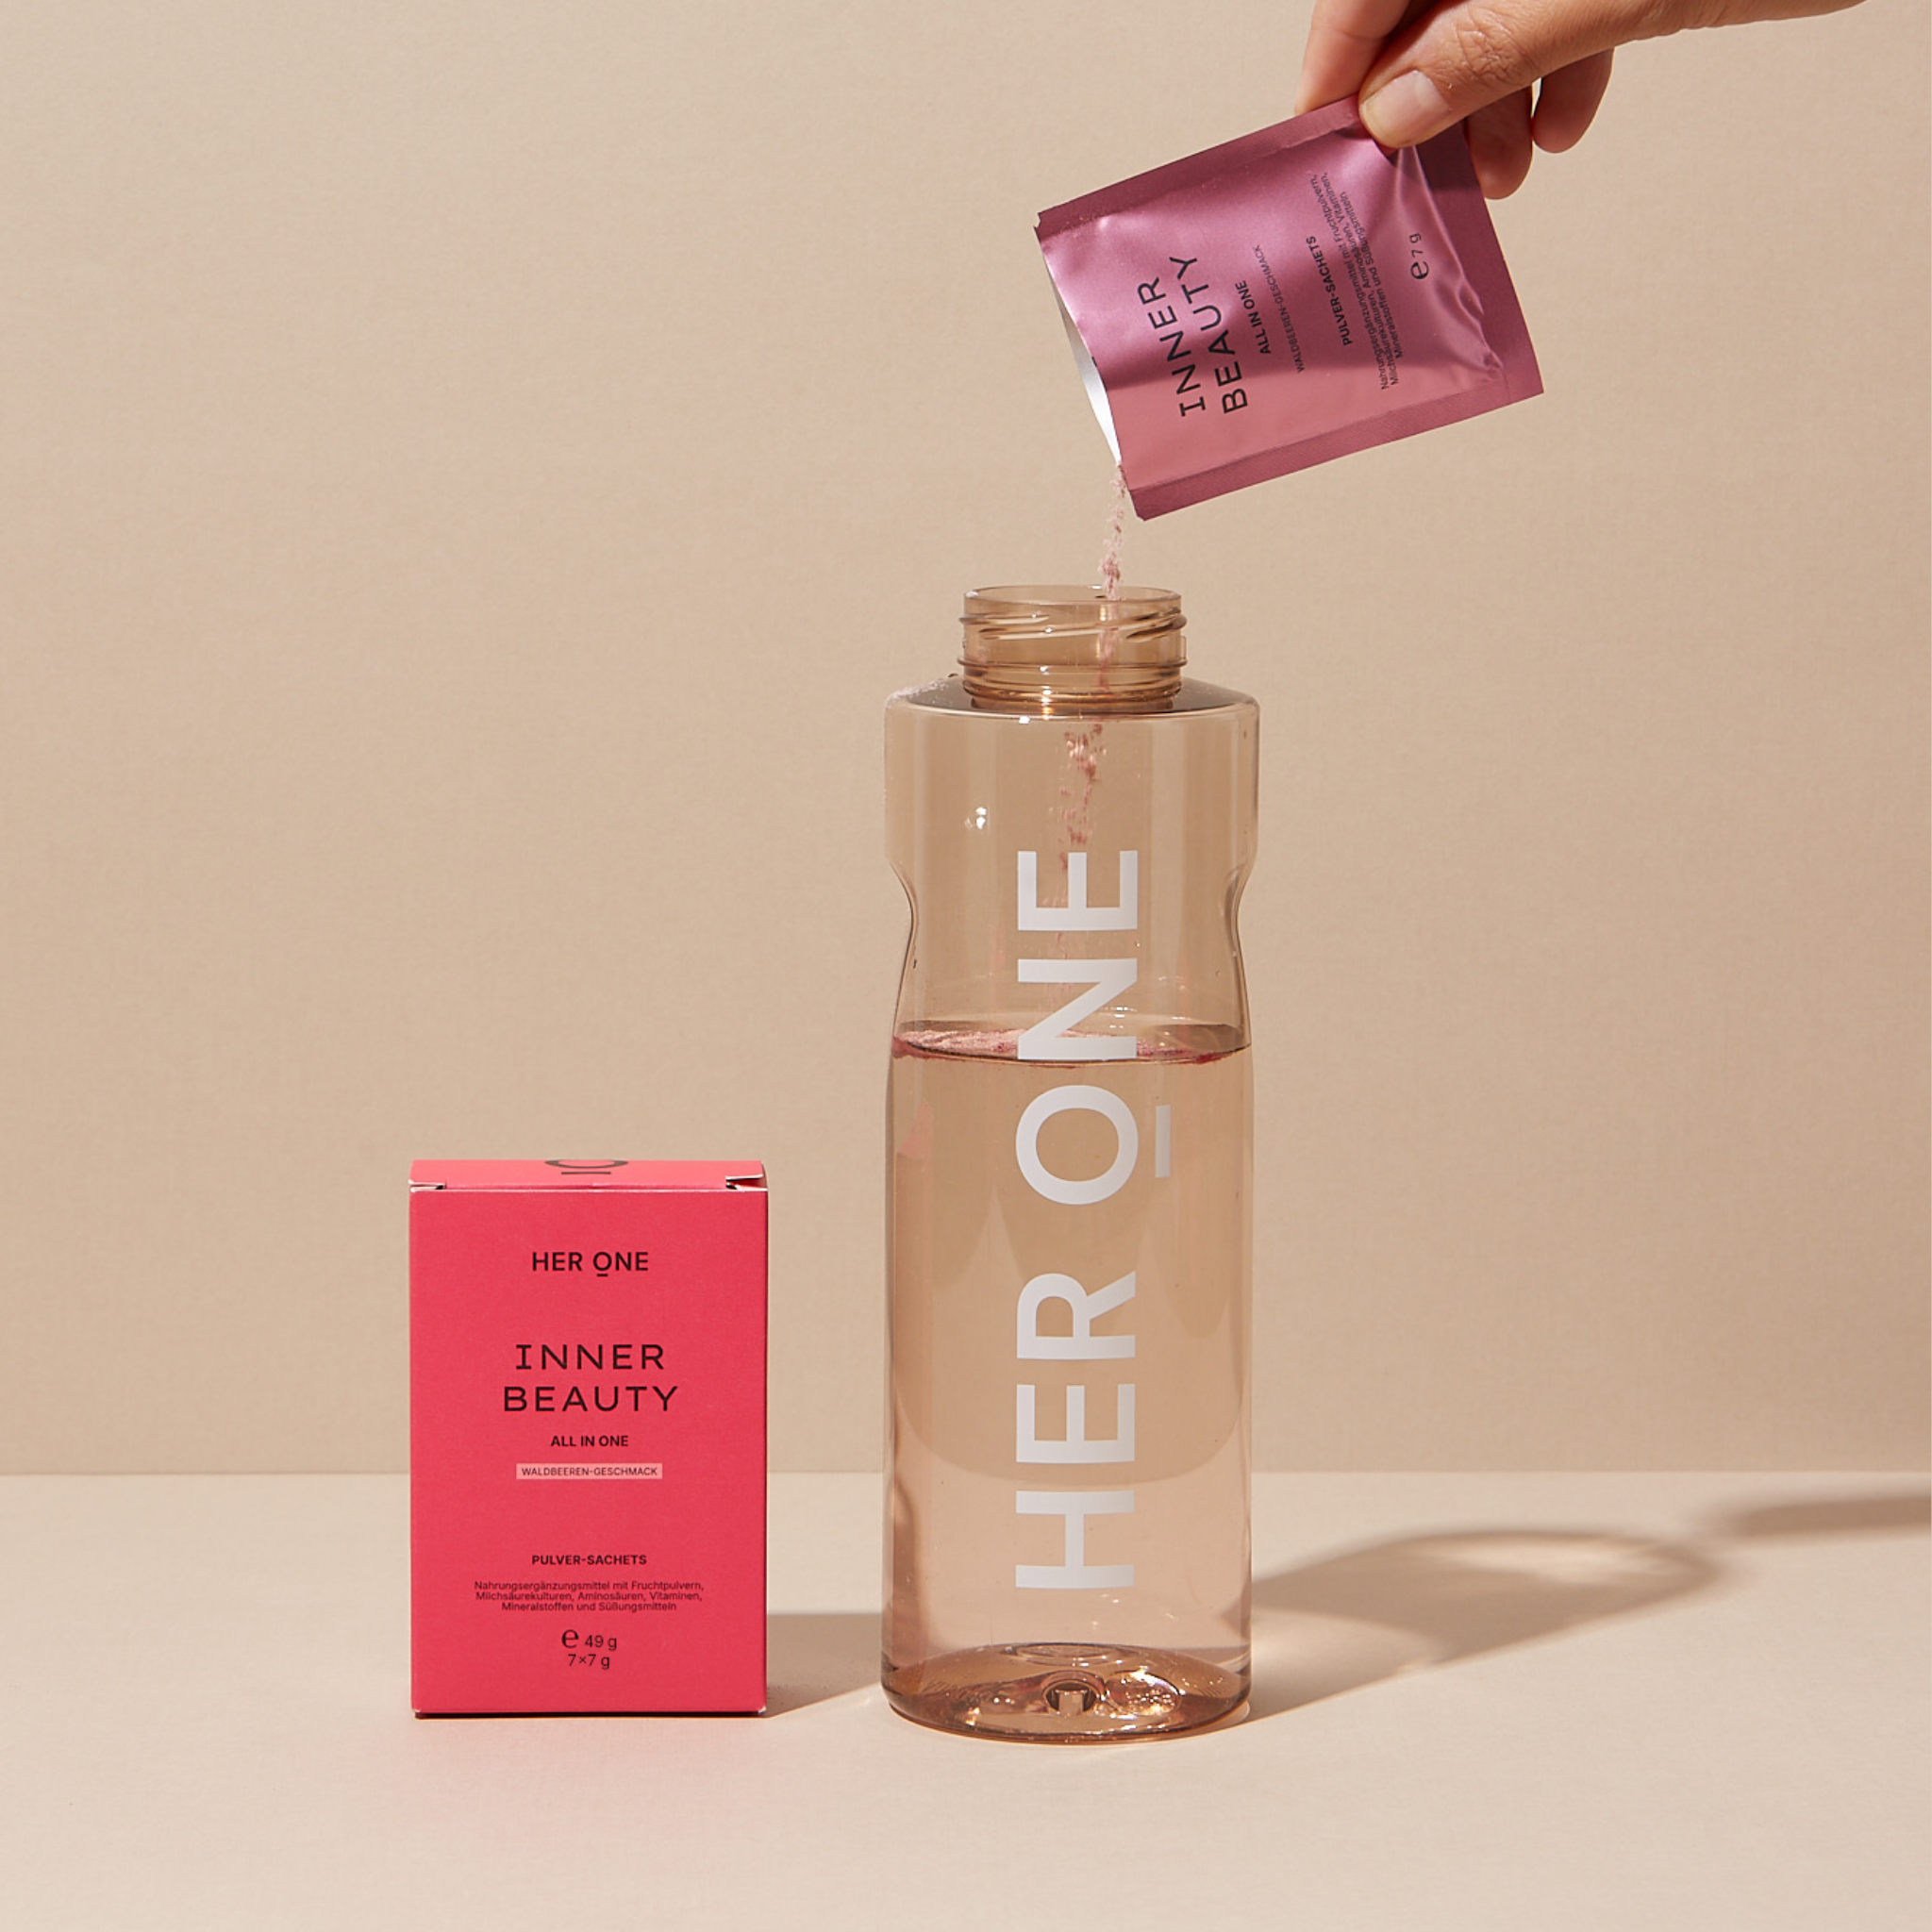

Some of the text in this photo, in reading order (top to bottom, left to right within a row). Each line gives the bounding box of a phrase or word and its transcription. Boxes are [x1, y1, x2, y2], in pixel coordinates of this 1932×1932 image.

[1408, 232, 1422, 244] g
[1410, 249, 1424, 258] 7
[1310, 174, 1390, 390] Nahrungsergänzungsmittel mit Fruchtpulvern,
[1321, 172, 1399, 386] Milchsäurekulturen, Aminosäuren, Vitaminen,
[1340, 192, 1404, 358] Mineralstoffen und Süßungsmitteln
[1306, 236, 1353, 346] PULVER-SACHETS
[1235, 280, 1272, 354] ALL IN ONE
[1253, 245, 1305, 374] WALDBEEREN-GESCHMACK
[1138, 277, 1206, 416] INNER
[1169, 257, 1247, 413] BEAUTY
[1015, 850, 1171, 1590] HER ONE
[532, 1251, 649, 1277] HER ONE
[515, 1343, 665, 1371] INNER
[504, 1386, 678, 1412] BEAUTY
[550, 1435, 629, 1447] ALL IN ONE
[521, 1467, 658, 1476] WALDBEEREN-GESCHMACK
[531, 1555, 647, 1566] PULVER-SACHETS
[475, 1580, 705, 1591] Nahrungsergänzungsmittel mit Fruchtpulvern,
[475, 1591, 703, 1602] Milchsäurekulturen, Aminosäuren, Vitaminen,
[501, 1602, 677, 1612] Mineralstoffen und Süßungsmitteln
[584, 1635, 605, 1648] 49
[608, 1638, 618, 1652] g
[601, 1657, 611, 1670] g
